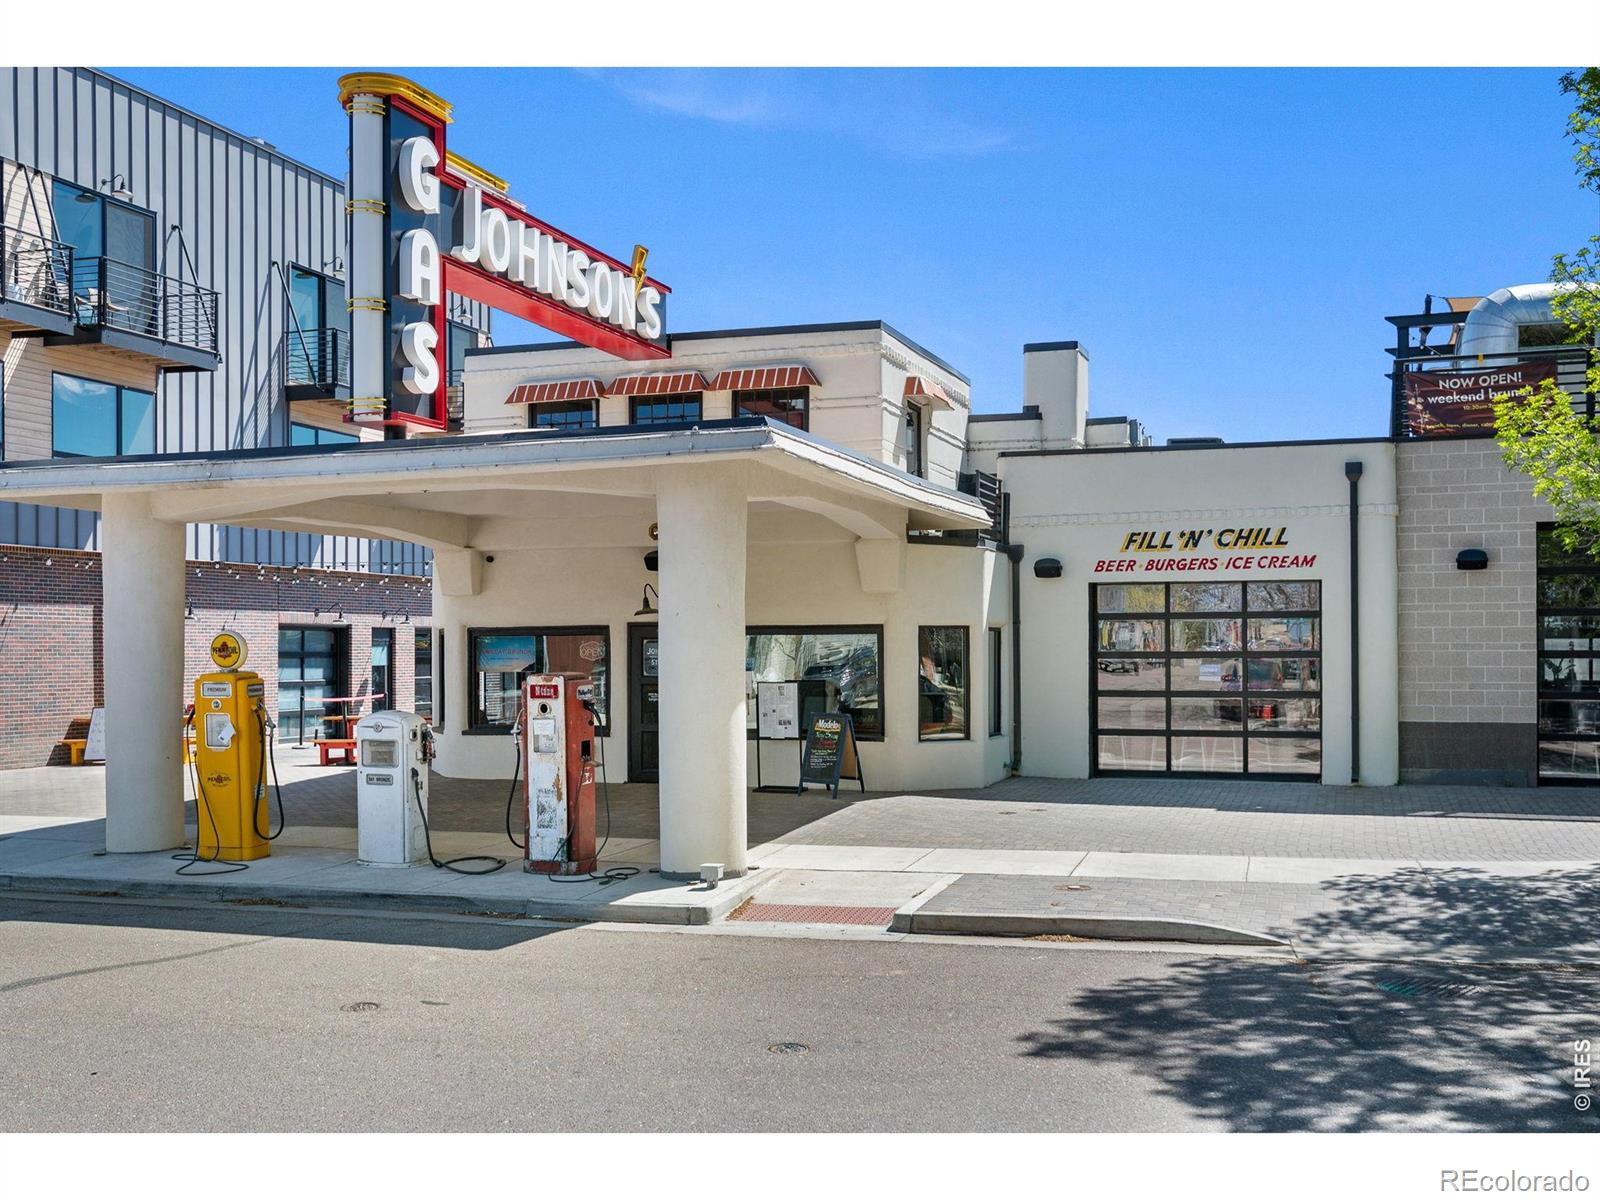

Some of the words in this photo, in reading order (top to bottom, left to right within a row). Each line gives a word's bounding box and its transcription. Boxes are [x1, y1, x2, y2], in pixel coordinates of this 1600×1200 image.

[399, 135, 440, 394] GAS
[451, 187, 661, 339] JOHNSON'S
[1439, 377, 1475, 389] NOW
[1479, 372, 1522, 387] OPEN!
[1427, 389, 1484, 404] weekend
[1120, 530, 1174, 552] FILL
[1214, 527, 1289, 550] CHILL
[1094, 559, 1137, 573] BEER
[1144, 557, 1218, 571] BURGERS
[1225, 556, 1255, 570] ICE
[1257, 555, 1317, 569] CREAM
[817, 719, 840, 729] Modelo
